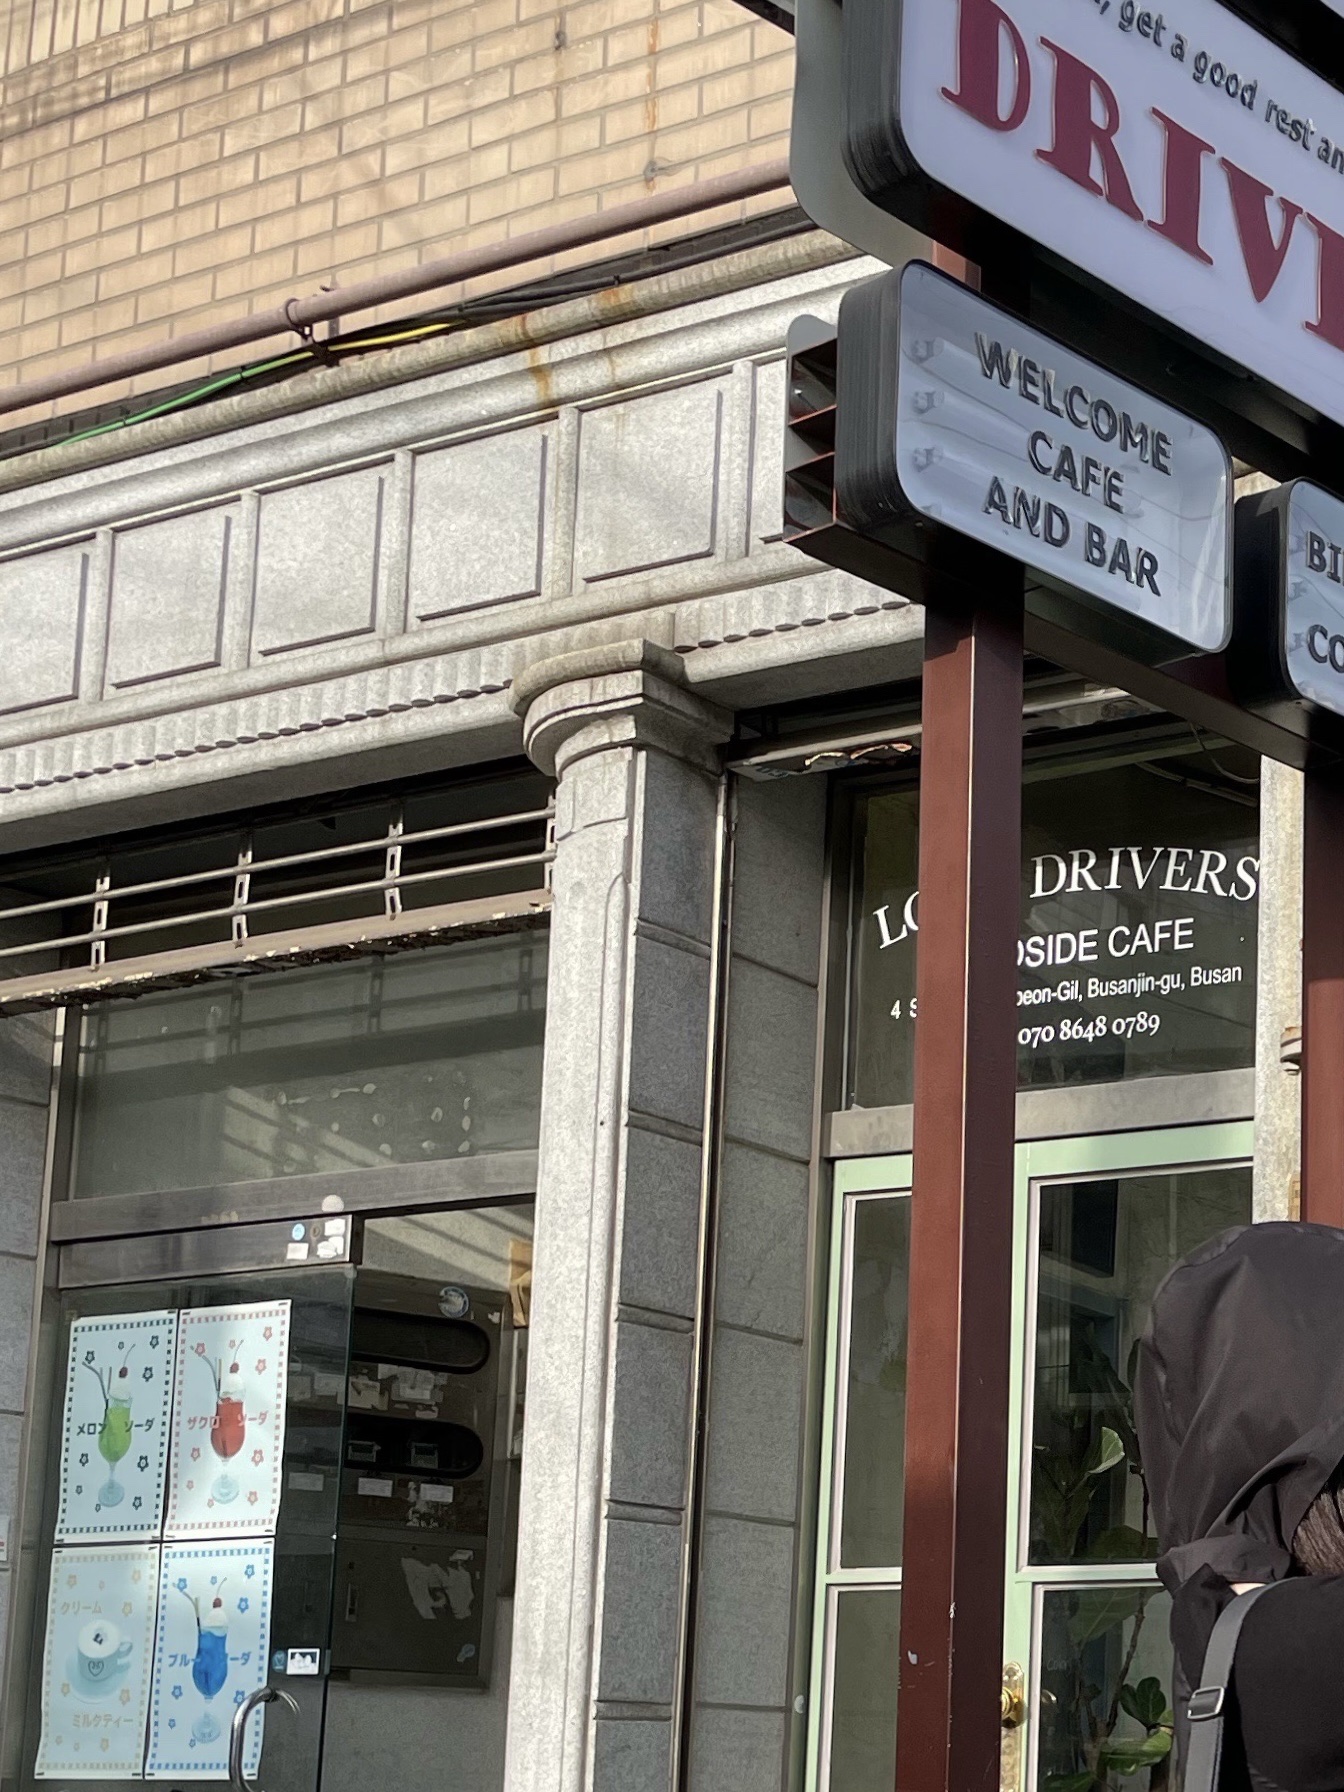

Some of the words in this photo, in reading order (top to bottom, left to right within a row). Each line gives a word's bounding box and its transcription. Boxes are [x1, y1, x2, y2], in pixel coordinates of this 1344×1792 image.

[1118, 0, 1166, 47] get
[1170, 33, 1187, 62] a
[1193, 50, 1258, 110] good
[1264, 99, 1316, 151] rest
[975, 331, 1172, 476] WELCOME
[1028, 430, 1124, 514] CAFE
[982, 476, 1070, 548] AND
[1085, 521, 1161, 597] BAR
[1029, 846, 1260, 901] DRIVERS
[1108, 917, 1194, 958] CAFE
[890, 999, 902, 1020] 4
[1087, 972, 1185, 998] Busanjin-gu,
[1190, 965, 1242, 987] Busan
[1017, 1024, 1055, 1049] 070
[1059, 1015, 1108, 1043] 8648
[1112, 1011, 1161, 1039] 0789
